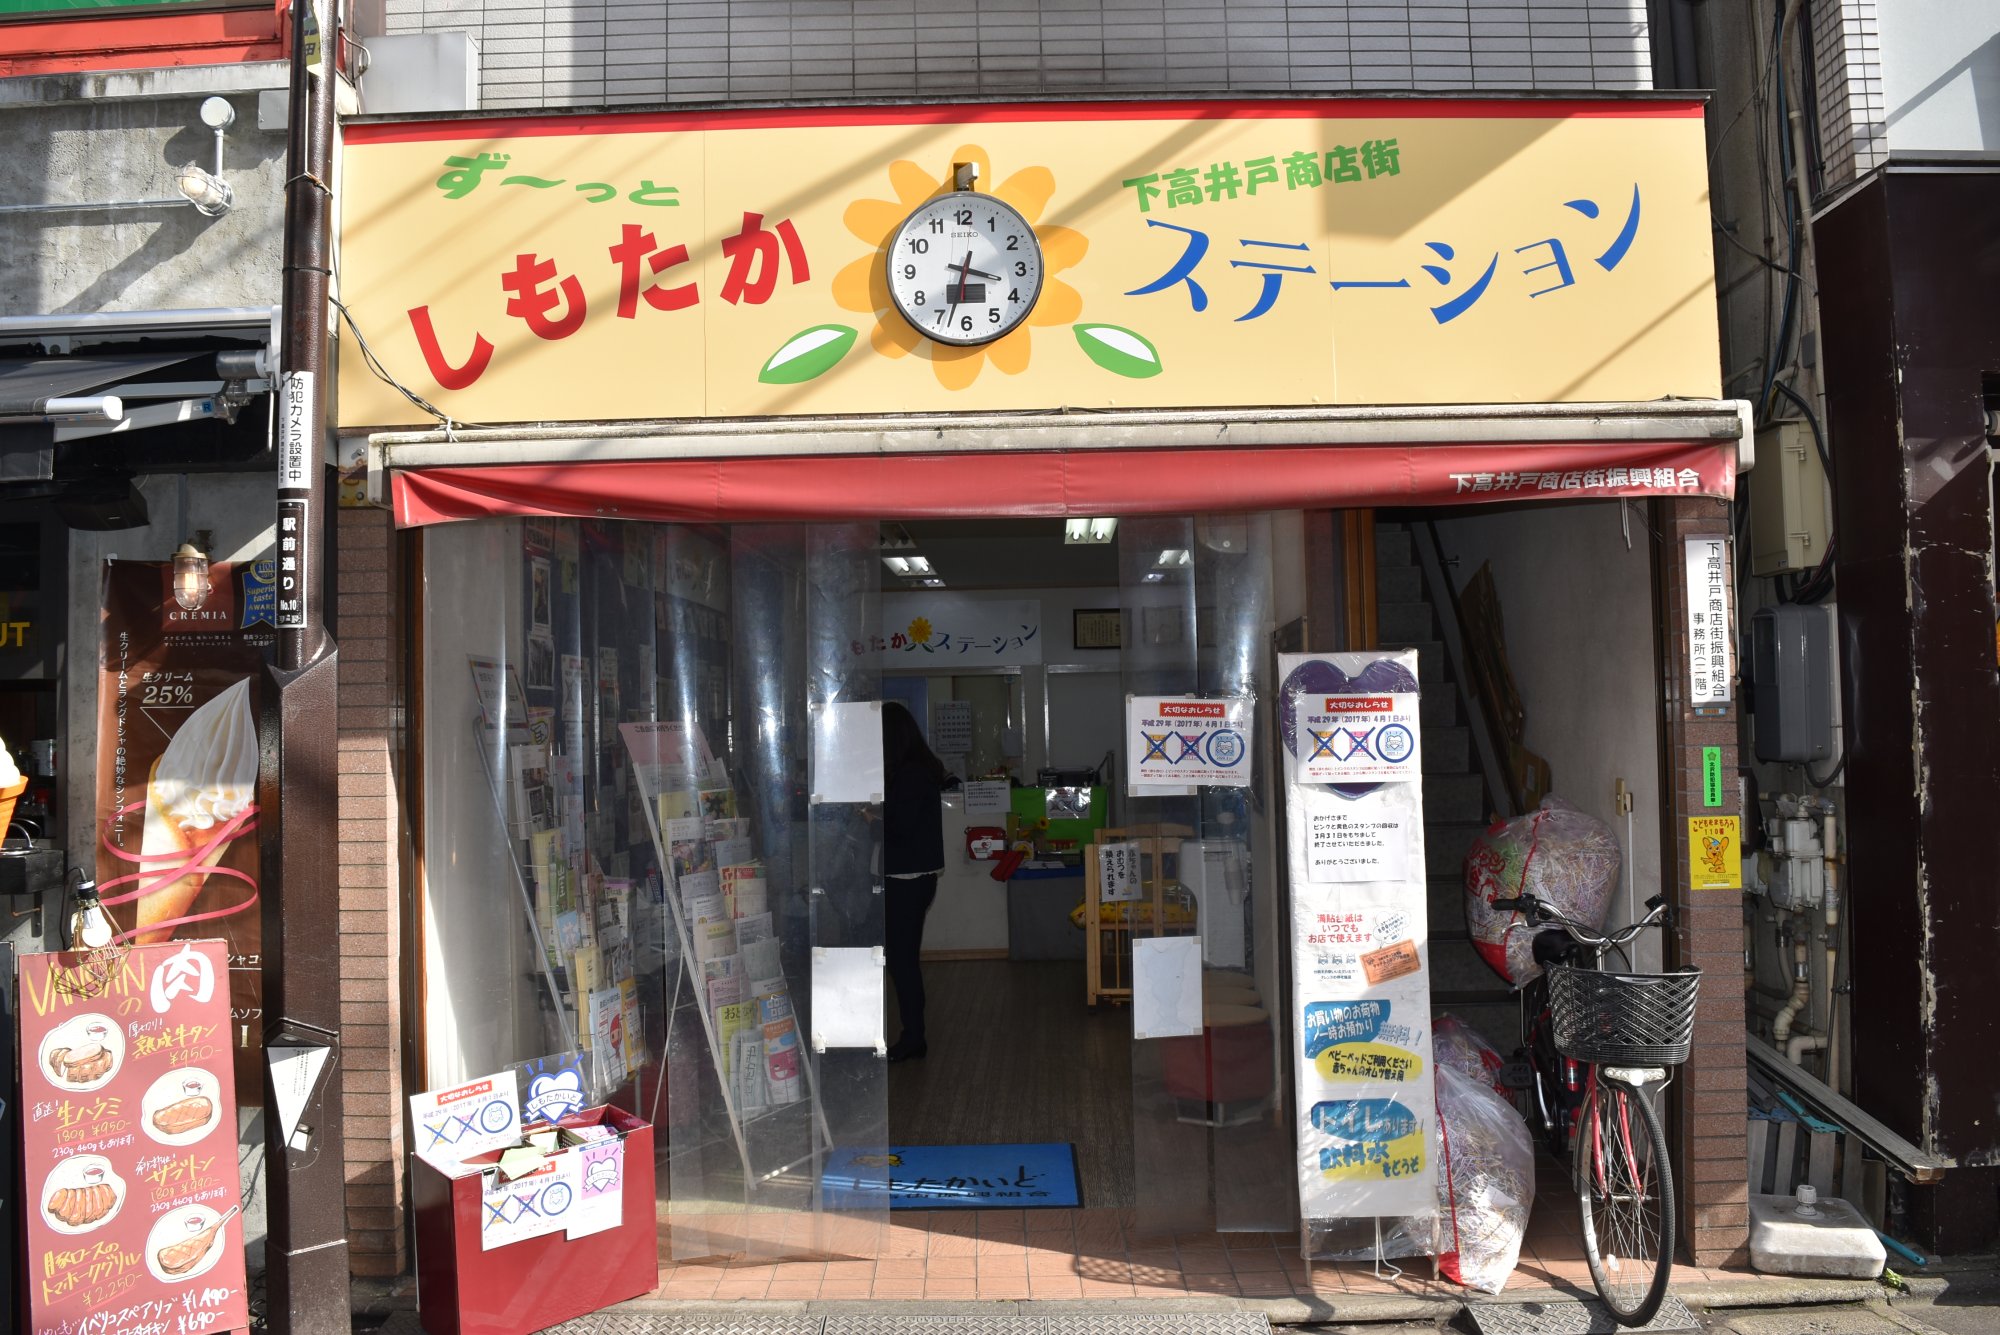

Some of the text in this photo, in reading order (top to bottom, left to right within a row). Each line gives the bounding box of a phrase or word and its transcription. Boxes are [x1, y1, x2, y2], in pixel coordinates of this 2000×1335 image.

[1122, 138, 1401, 213] 下高井戸商店街
[929, 218, 944, 234] 11
[953, 210, 973, 226] 12
[987, 217, 995, 232] 1
[908, 238, 929, 254] 10
[1006, 235, 1019, 251] 2
[904, 264, 916, 280] 9
[1014, 261, 1027, 277] 3
[406, 182, 1641, 391] しもたか ステーション
[913, 290, 926, 306] 8
[1007, 288, 1020, 304] 4
[934, 309, 946, 325] 7
[960, 315, 973, 332] 6
[988, 308, 1001, 324] 5
[288, 377, 304, 482] 防犯カメラ設置中
[1449, 467, 1700, 494] 下高井戸商店街振興組合
[281, 516, 297, 591] 駅前通り
[280, 599, 298, 611] No.10
[168, 611, 228, 621] CREMIA
[1706, 542, 1725, 697] 下高井戸商店街振興組合
[934, 624, 1038, 655] ステーション
[1693, 612, 1707, 696] 事務所(二階)
[142, 672, 194, 684] 生クリーム
[142, 685, 194, 705] 25%
[1163, 706, 1221, 714] 大切なおしらせ
[1329, 701, 1389, 709] 大切なおしらせ
[1313, 814, 1348, 822] おかげさまで
[1322, 924, 1359, 933] いつでも
[1308, 933, 1373, 944] お店で使えます
[150, 943, 215, 1013] 肉
[1307, 1001, 1381, 1028] お買い物のお荷物
[1319, 1019, 1374, 1041] 一時お預かり
[530, 1092, 577, 1109] しもたかいど
[56, 1129, 85, 1145] 180g
[1319, 1141, 1391, 1171] 飲料水
[145, 1154, 215, 1187] ザブトン
